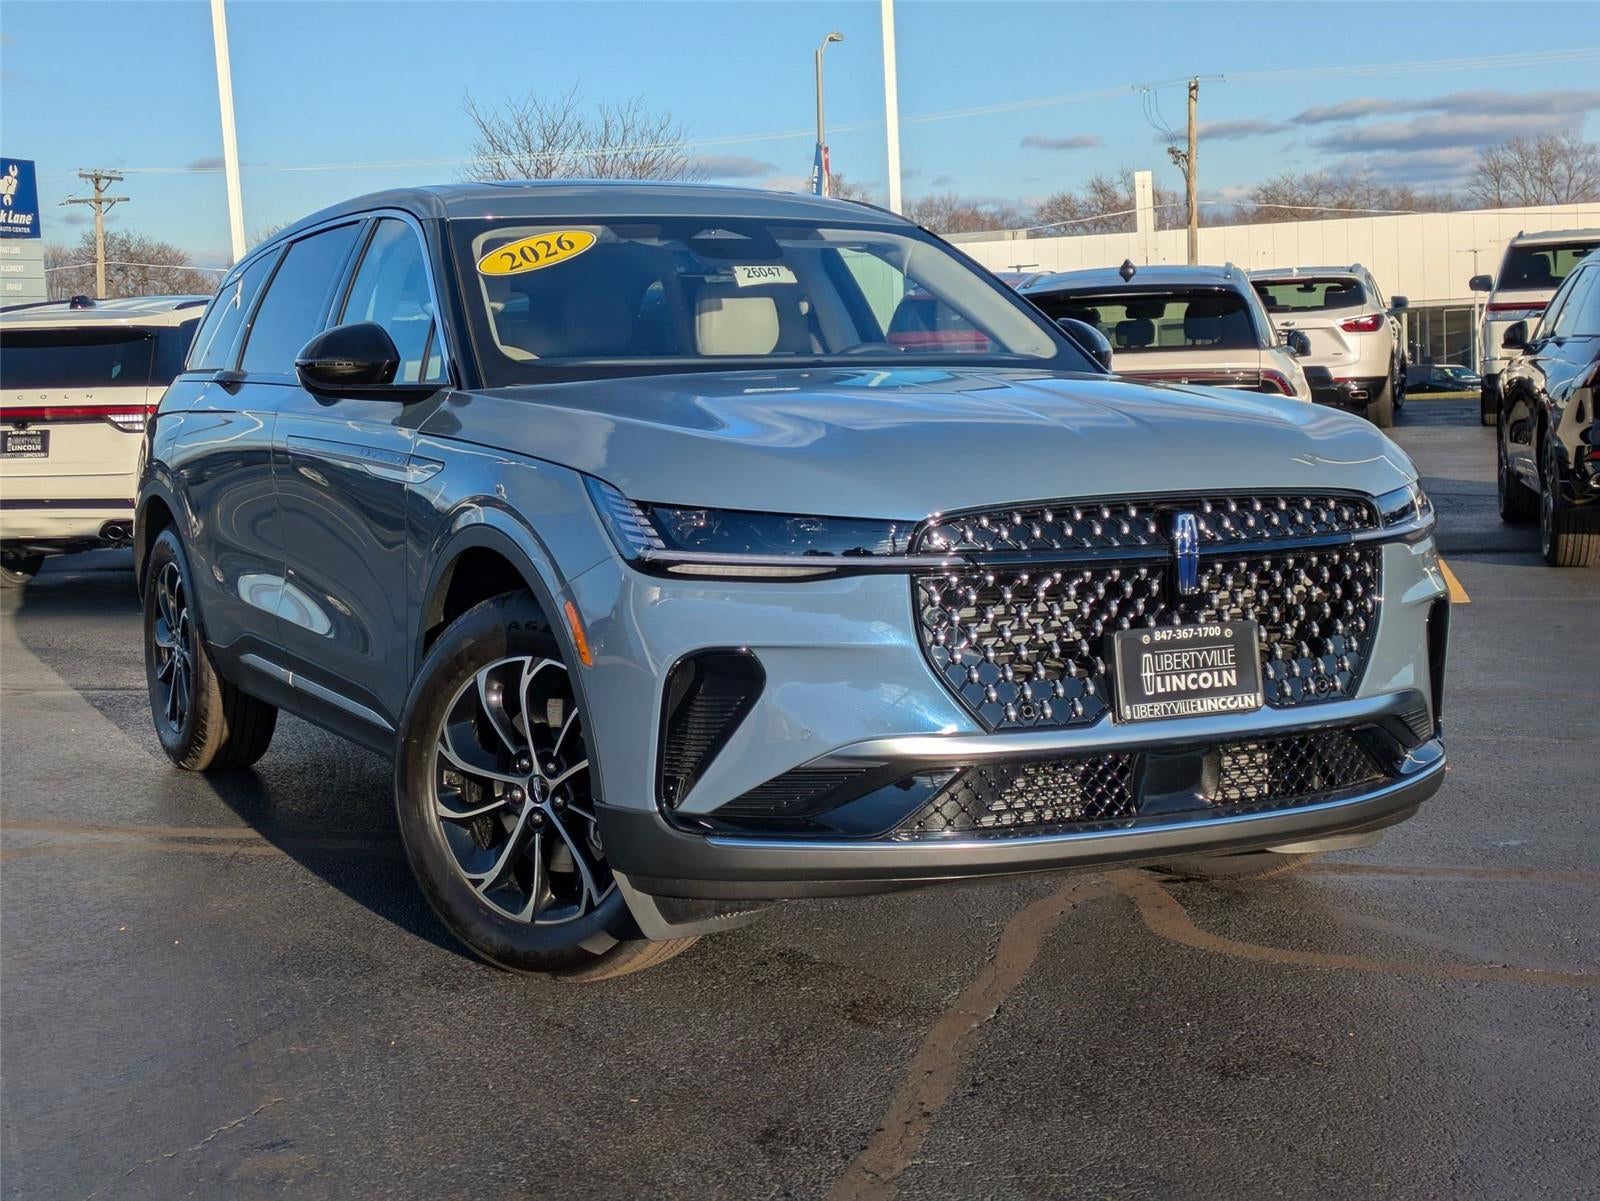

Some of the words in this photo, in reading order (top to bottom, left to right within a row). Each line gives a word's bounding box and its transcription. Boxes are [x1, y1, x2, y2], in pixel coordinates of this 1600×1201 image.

[7, 210, 33, 225] Lane
[500, 234, 575, 271] 2026
[743, 267, 781, 278] 26047
[1154, 626, 1221, 641] 847-367-1700
[1155, 648, 1236, 671] LIBERTYVILLE
[1156, 670, 1237, 693] LINCOLN
